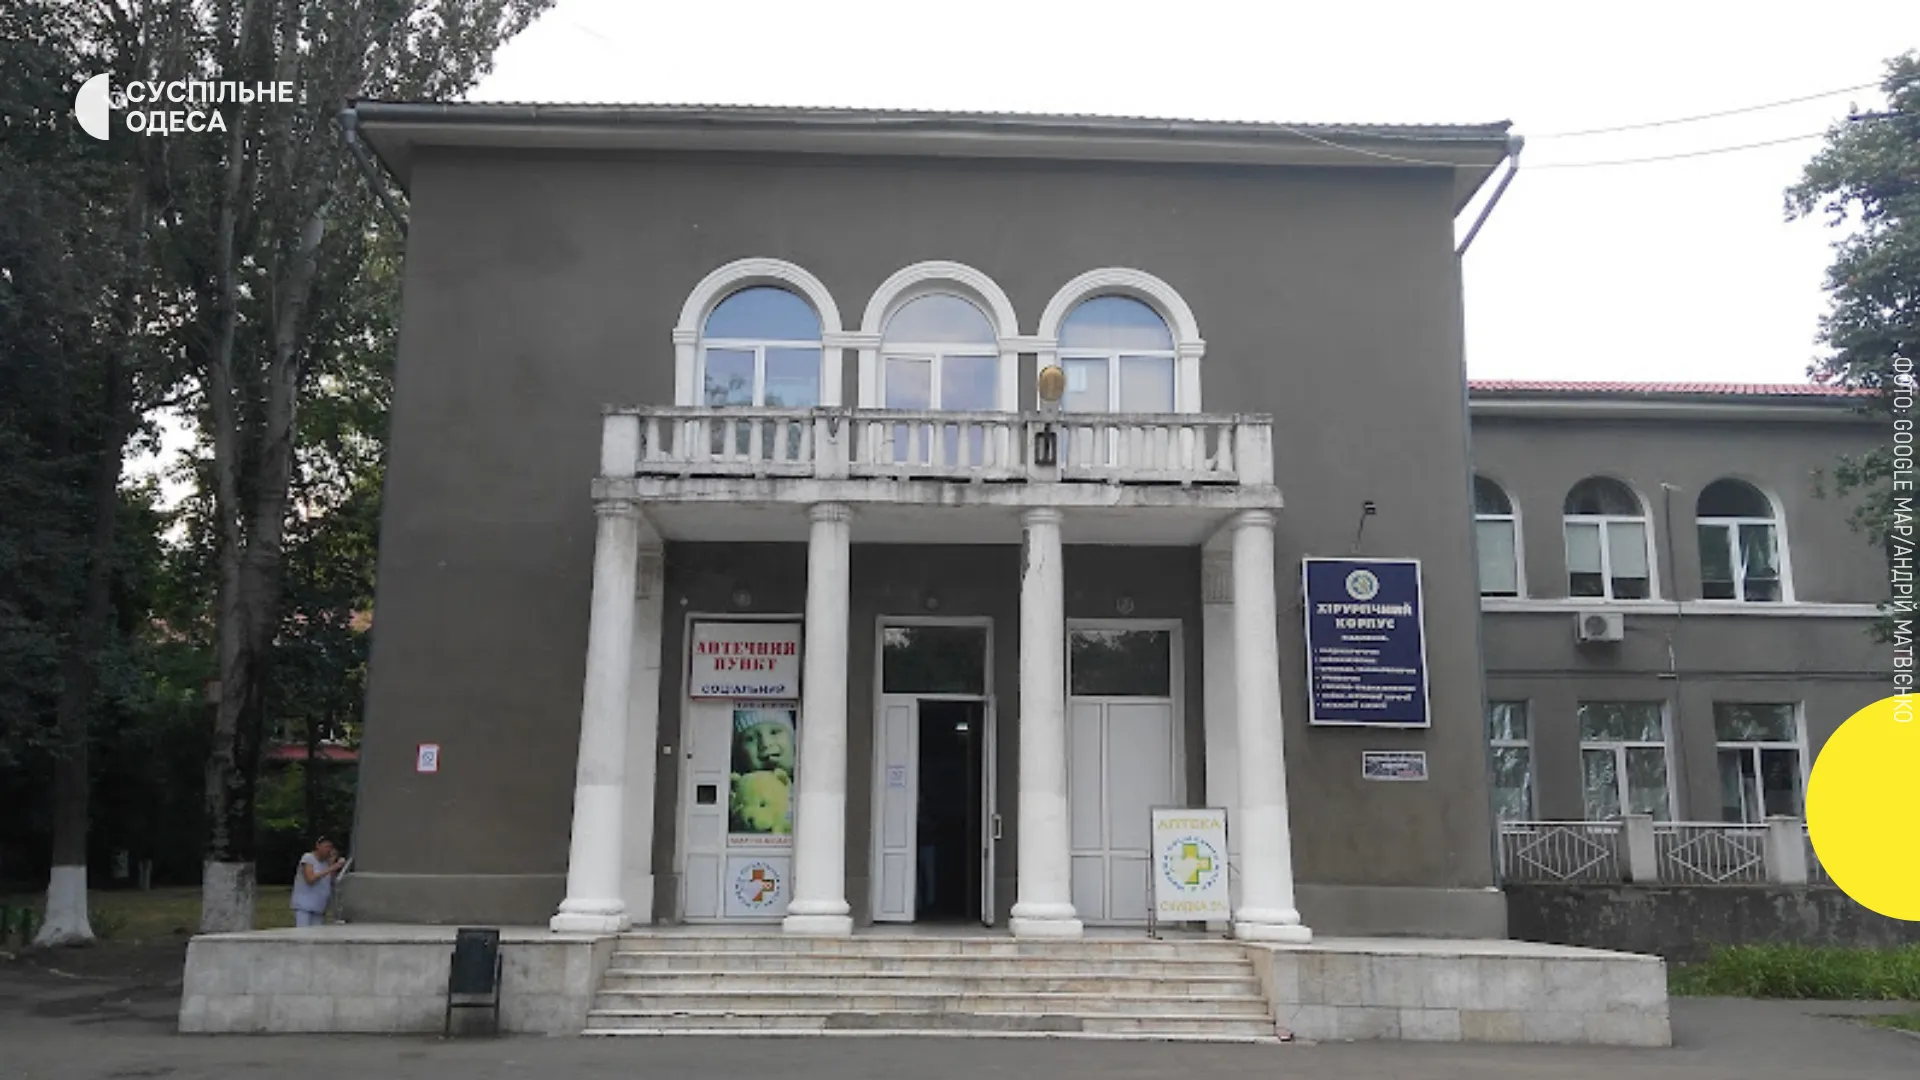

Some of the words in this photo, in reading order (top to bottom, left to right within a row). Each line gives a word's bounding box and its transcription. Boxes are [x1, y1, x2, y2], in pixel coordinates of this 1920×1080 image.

[1316, 602, 1412, 616] ХІРУРГІЧНИЙ
[1335, 617, 1395, 629] КОРПУС
[714, 657, 777, 671] ПУНКТ
[1157, 818, 1221, 830] АПТЕКА
